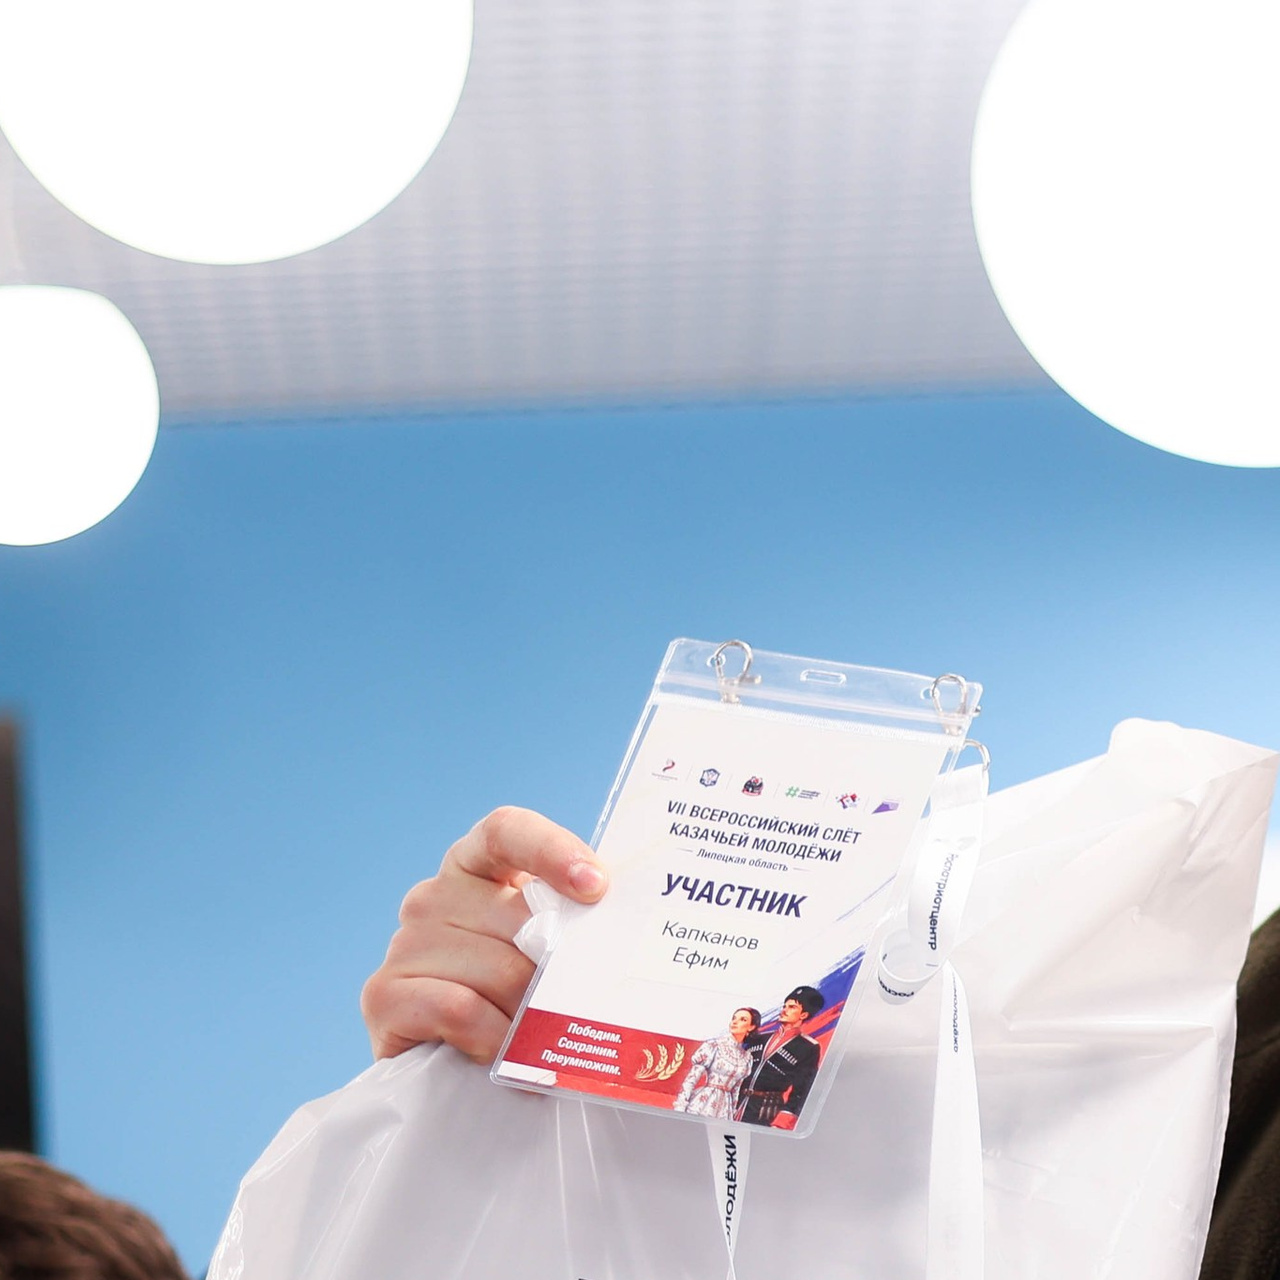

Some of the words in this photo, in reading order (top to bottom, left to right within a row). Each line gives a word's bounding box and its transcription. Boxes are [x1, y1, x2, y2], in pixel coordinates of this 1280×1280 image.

[667, 800, 687, 816] VII
[689, 804, 820, 838] ВСЕРОССИЙСКИЙ
[822, 826, 862, 844] СЛЁТ
[669, 822, 750, 848] КАЗАЧЬЕЙ
[751, 837, 843, 863] МОЛОДЁЖИ
[697, 848, 747, 866] Липецкая
[748, 857, 789, 872] область
[661, 873, 808, 918] УЧАСТНИК
[662, 920, 760, 950] Капканов
[672, 946, 729, 970] Ефим
[567, 1022, 622, 1044] Победим.
[557, 1036, 619, 1059] Сохраним.
[541, 1050, 621, 1076] Преумножим.
[724, 1134, 737, 1247] ЛОДЁЖИ
